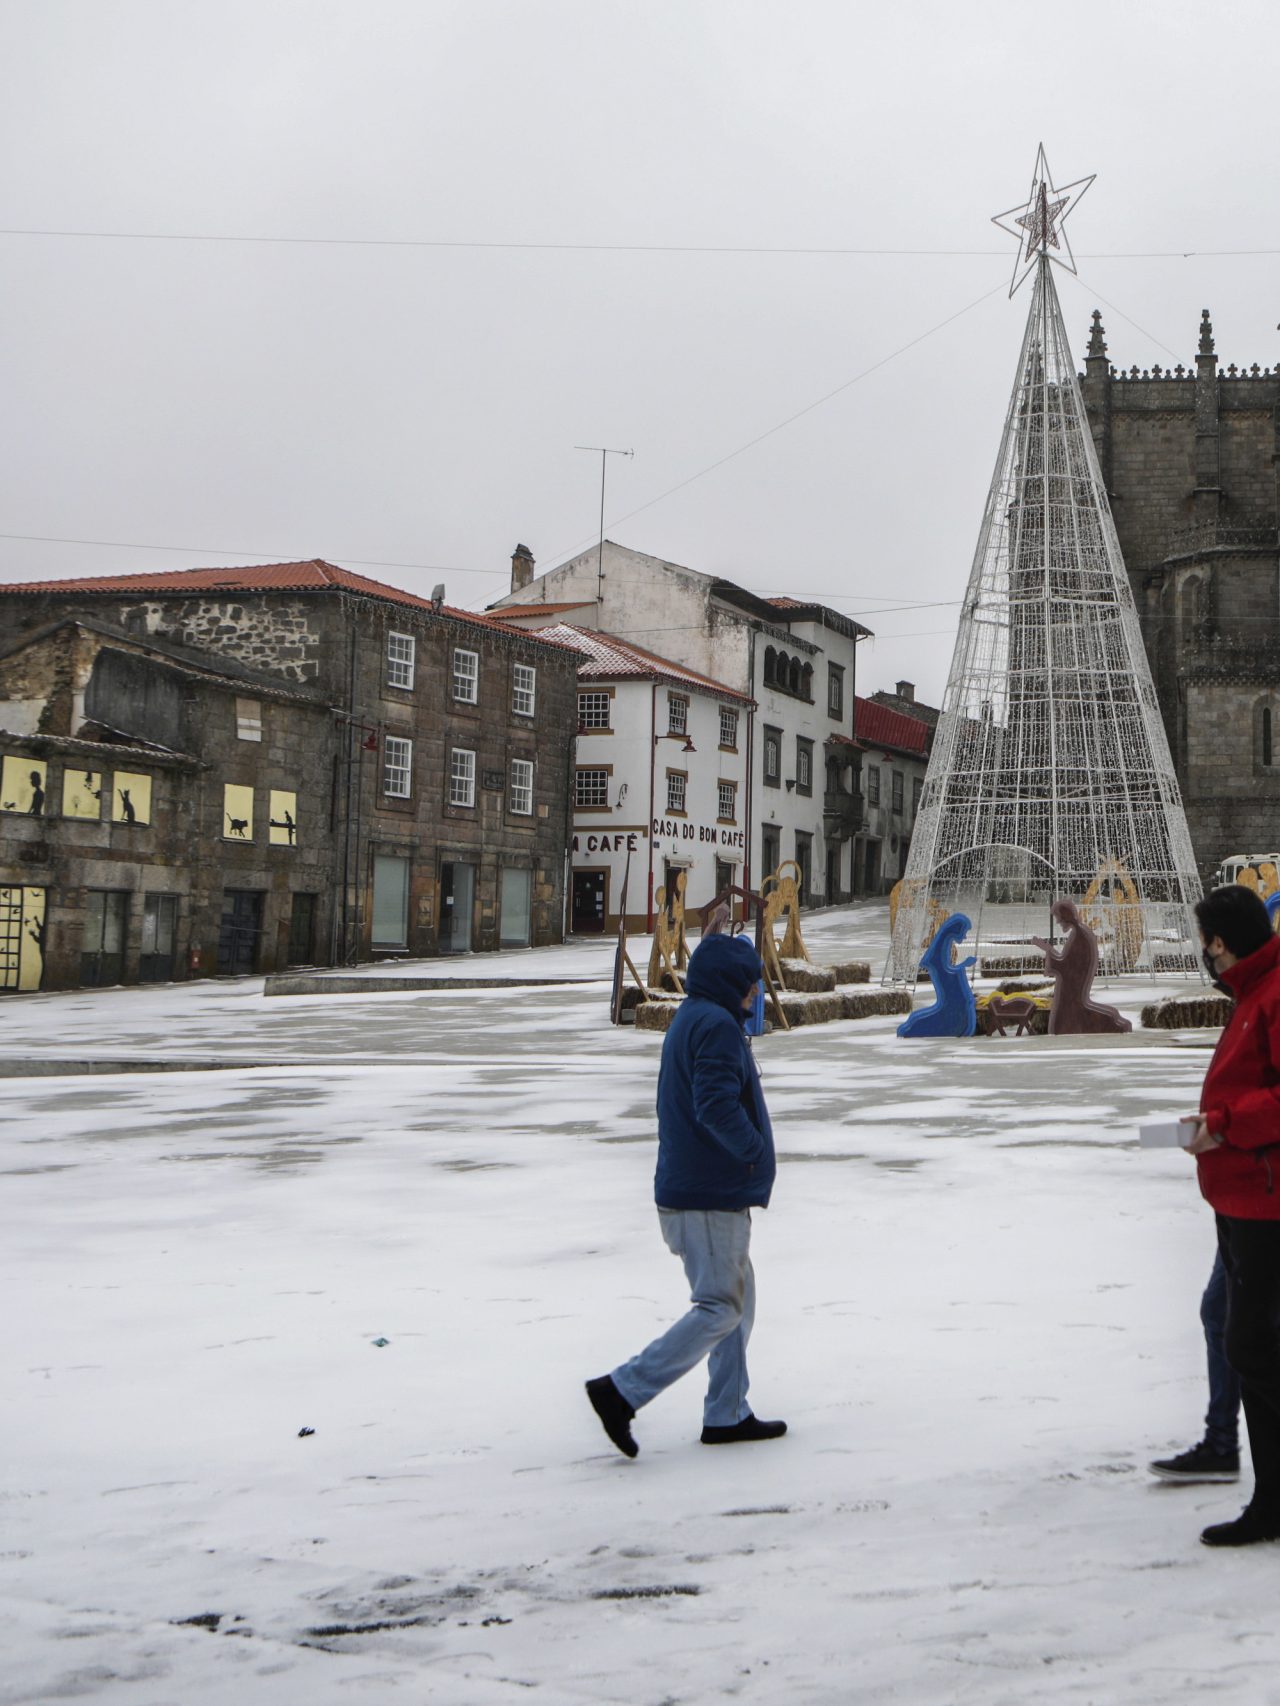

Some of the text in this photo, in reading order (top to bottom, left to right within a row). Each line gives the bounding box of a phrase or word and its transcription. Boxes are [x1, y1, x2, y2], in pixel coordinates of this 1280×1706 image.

[587, 833, 638, 852] CAFÉ
[653, 818, 744, 849] CASA DO BOM CAFÉ
